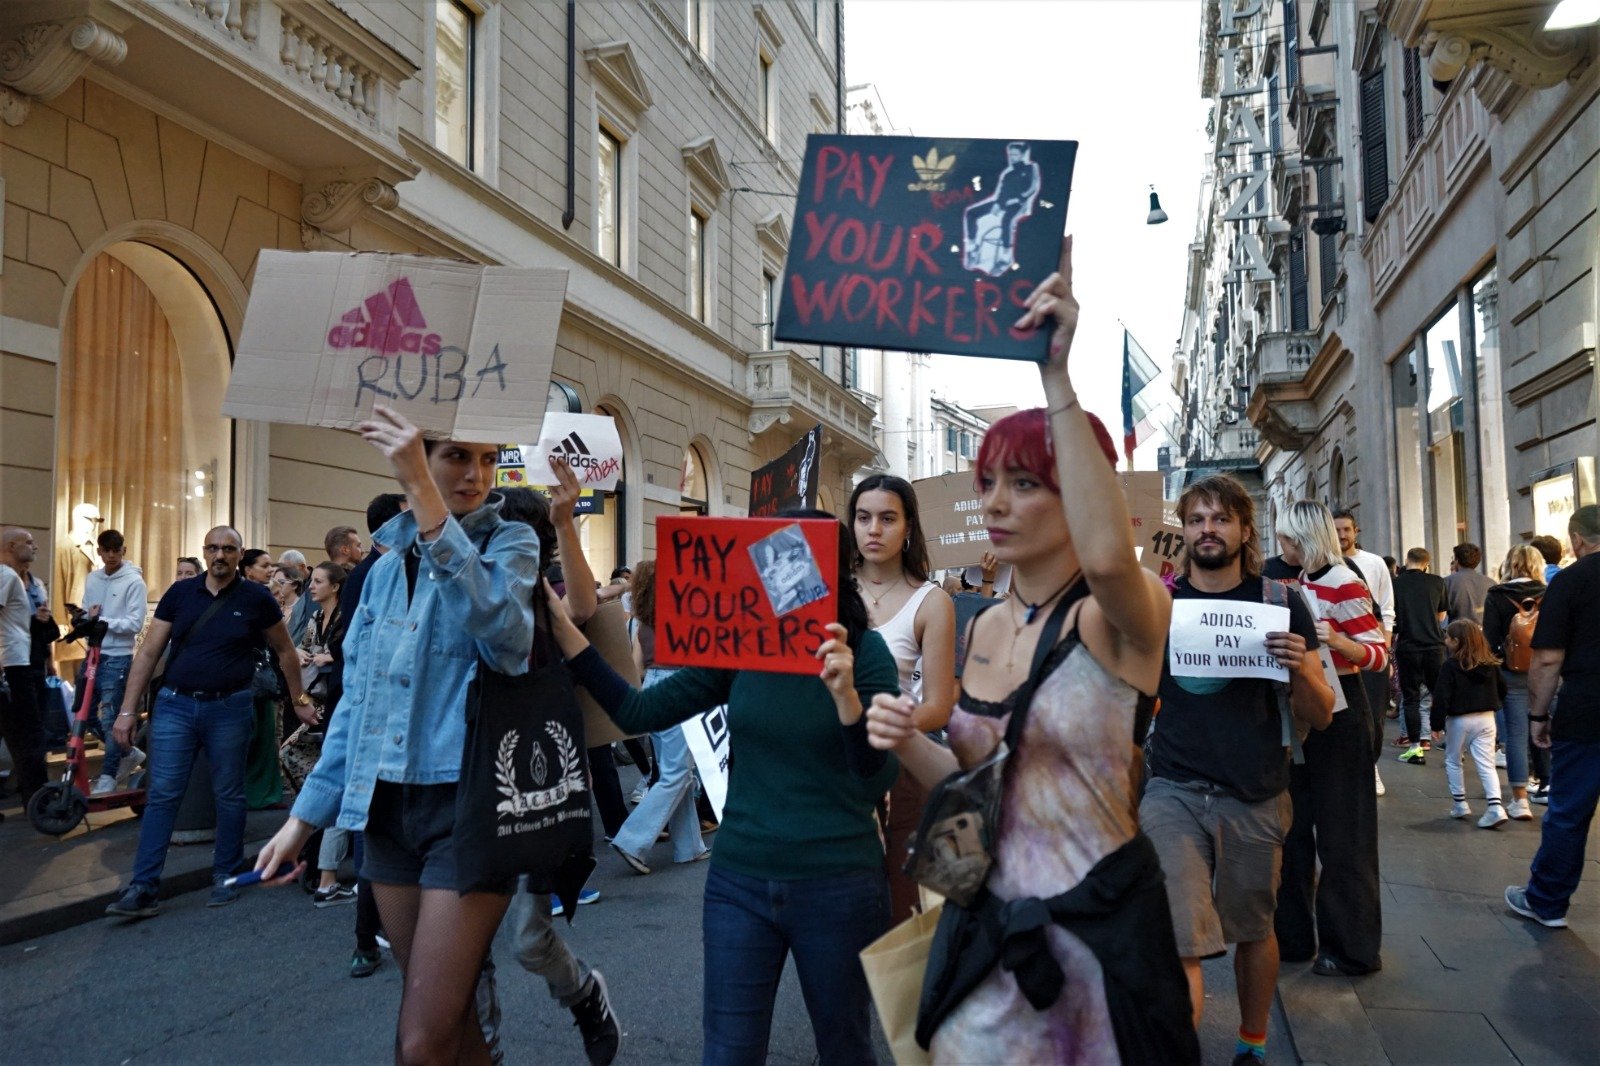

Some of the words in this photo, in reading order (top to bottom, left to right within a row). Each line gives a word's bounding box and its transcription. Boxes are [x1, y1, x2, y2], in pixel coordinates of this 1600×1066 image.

[814, 145, 895, 208] PAY
[804, 211, 944, 276] YOUR
[790, 273, 1038, 343] WORKERS
[355, 344, 507, 407] RUBA
[954, 499, 984, 512] ADIDA
[966, 515, 985, 526] PAY
[672, 529, 737, 583] PAY
[939, 532, 965, 546] YOUR
[669, 580, 763, 624] YOUR
[665, 615, 827, 658] WORKERS
[1215, 634, 1241, 648] PAY
[1174, 652, 1211, 667] YOUR
[497, 825, 512, 837] All
